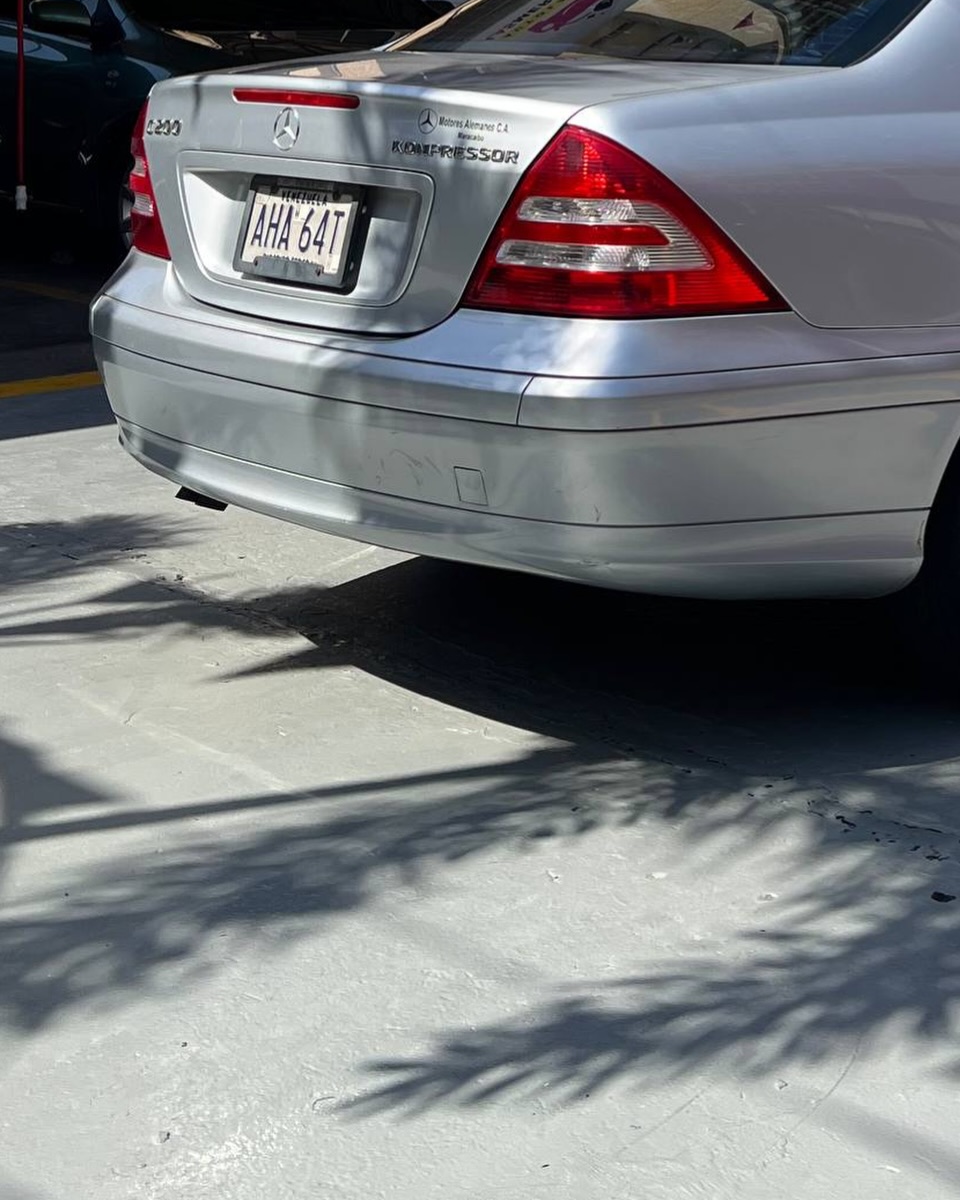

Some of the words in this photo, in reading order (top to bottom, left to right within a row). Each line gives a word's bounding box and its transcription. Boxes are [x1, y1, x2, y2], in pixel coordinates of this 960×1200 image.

[438, 116, 463, 129] Motores
[464, 119, 495, 132] Alemanes
[391, 140, 520, 165] KOMPRESSOR
[281, 189, 328, 207] VENEZUELA
[250, 202, 294, 251] AHA
[298, 207, 346, 256] 64T
